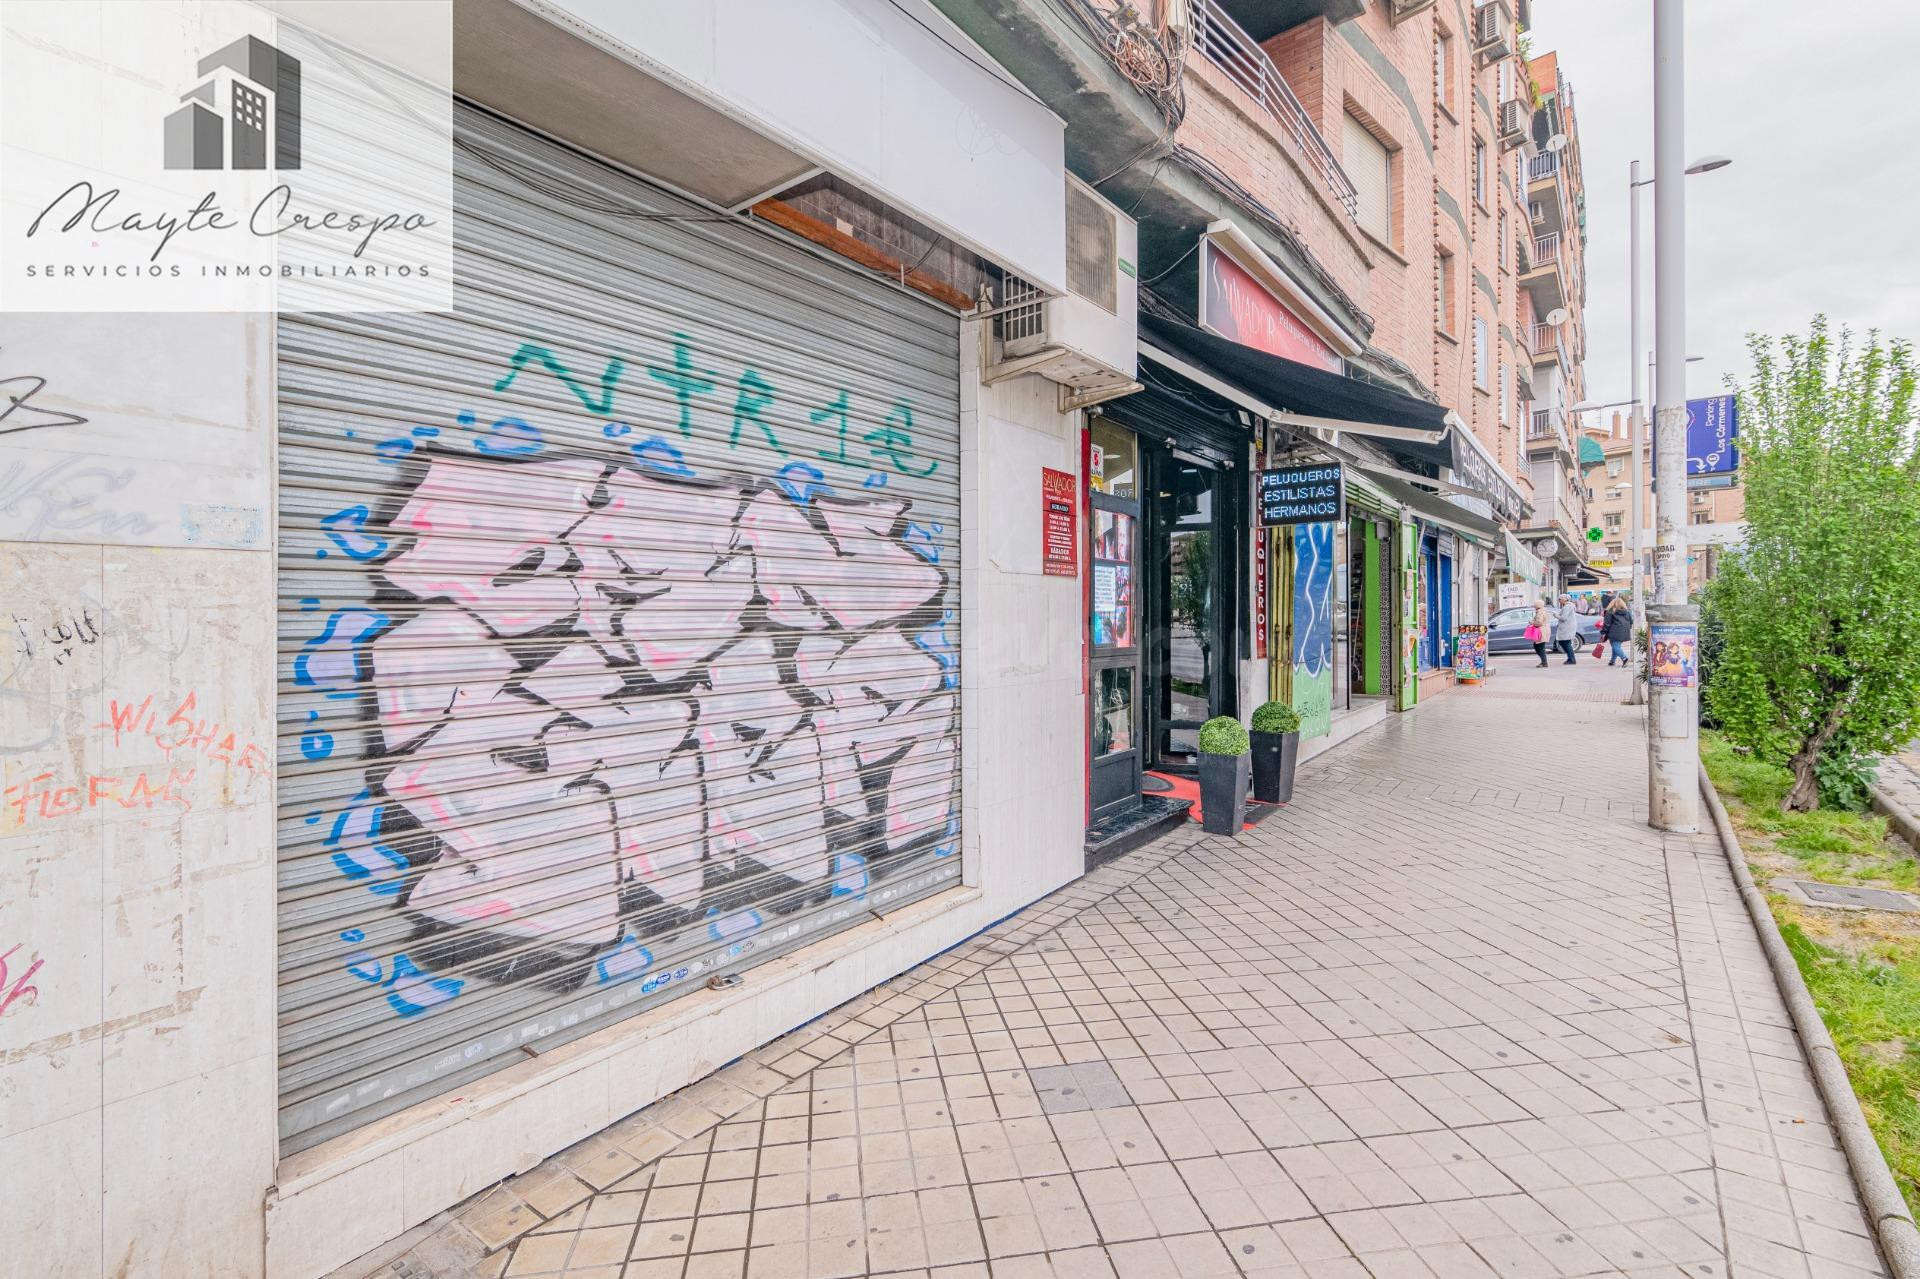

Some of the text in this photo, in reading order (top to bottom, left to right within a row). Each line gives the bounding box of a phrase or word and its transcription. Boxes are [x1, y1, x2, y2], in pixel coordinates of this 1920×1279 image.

[1705, 397, 1718, 428] Parking
[1717, 438, 1726, 453] Los
[1262, 468, 1340, 486] PELUQUEROS
[1264, 485, 1335, 503] ESTILISTAS
[1264, 502, 1336, 519] HERMANOS
